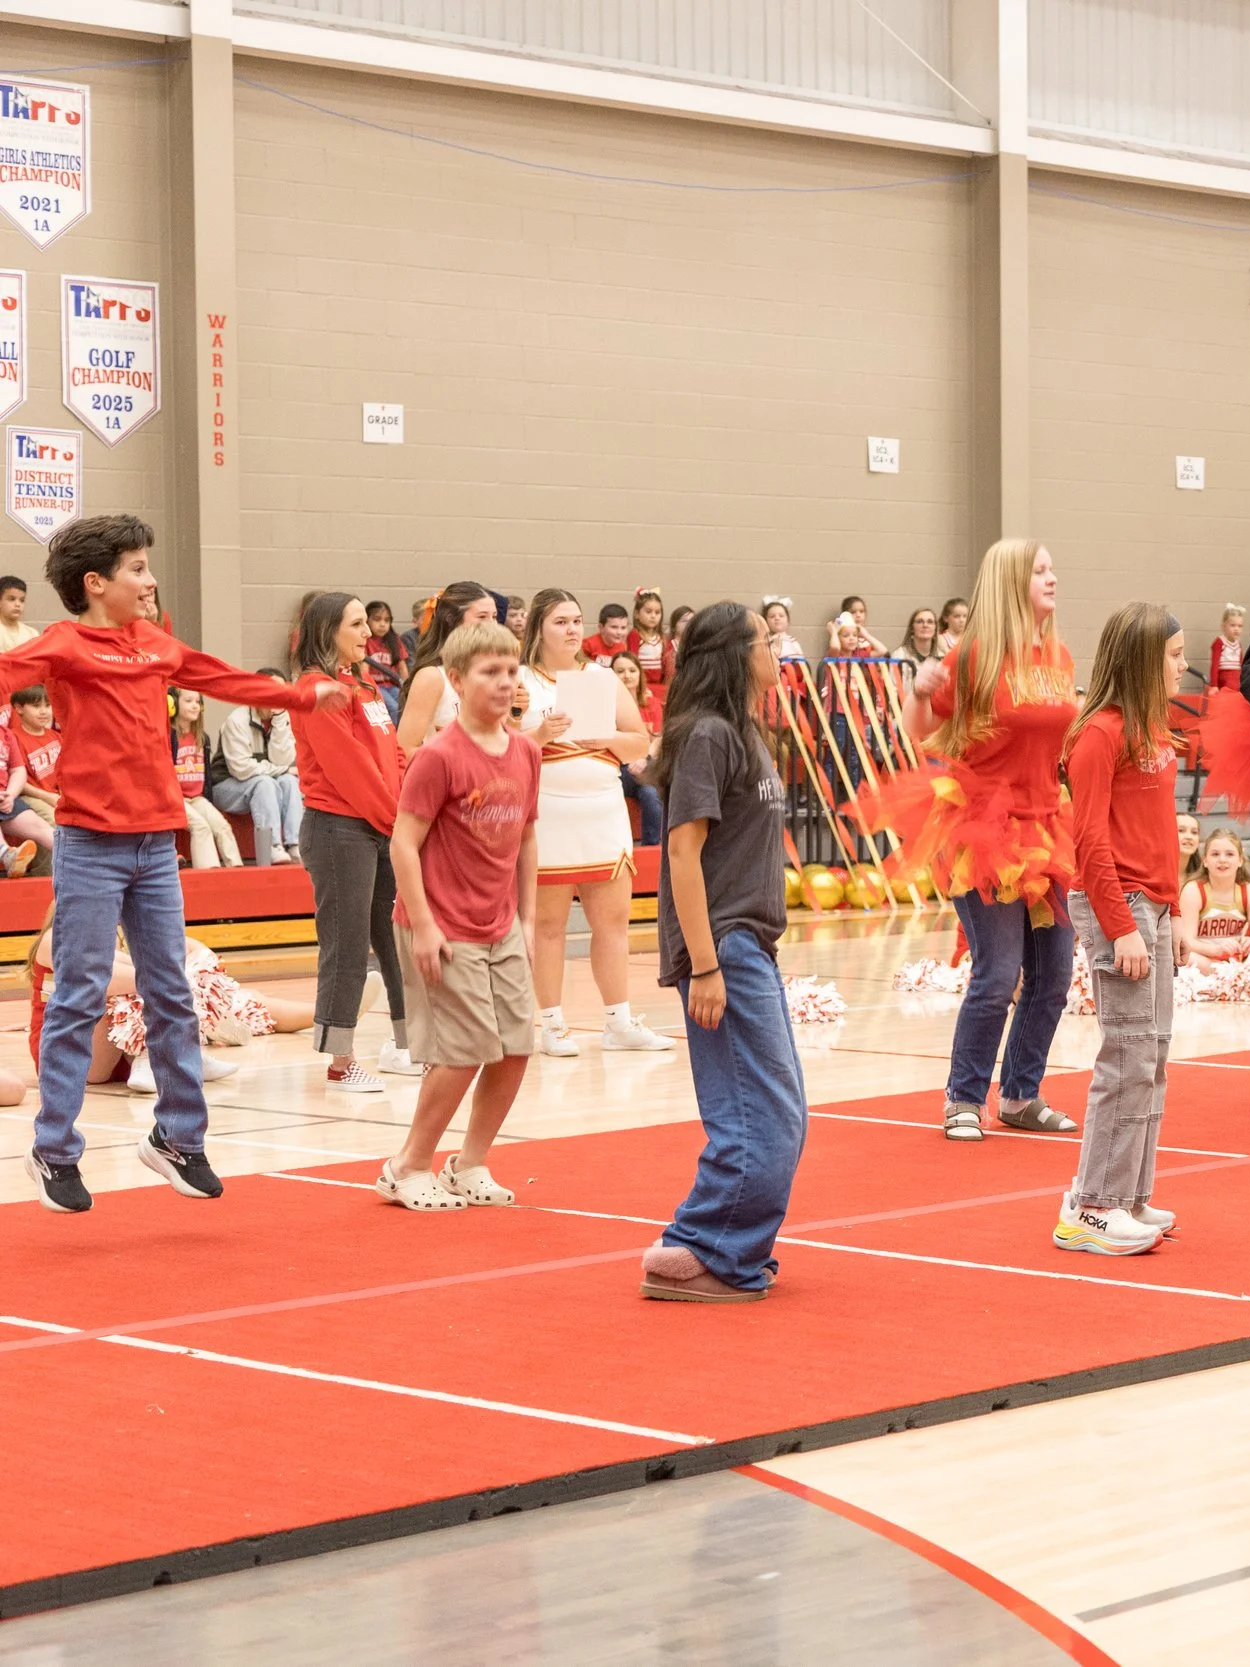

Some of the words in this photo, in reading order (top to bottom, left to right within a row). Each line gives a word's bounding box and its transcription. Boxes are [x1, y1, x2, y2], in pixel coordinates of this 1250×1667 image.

[30, 151, 81, 171] ATHLETICS
[0, 164, 81, 191] CHAMPION
[20, 195, 61, 213] 2021
[34, 219, 50, 232] 1A
[89, 348, 135, 369] GOLF
[71, 367, 152, 392] CHAMPION
[207, 314, 227, 466] WARRIORS
[92, 394, 133, 412] 2025
[106, 416, 121, 429] 1A
[367, 414, 399, 426] GRADE
[15, 470, 74, 485] DISTRICT
[15, 483, 74, 499] TENNIS
[15, 497, 74, 513] RUNNER-UP
[1197, 918, 1247, 937] ARRIOR
[1078, 1211, 1109, 1232] HOKA
